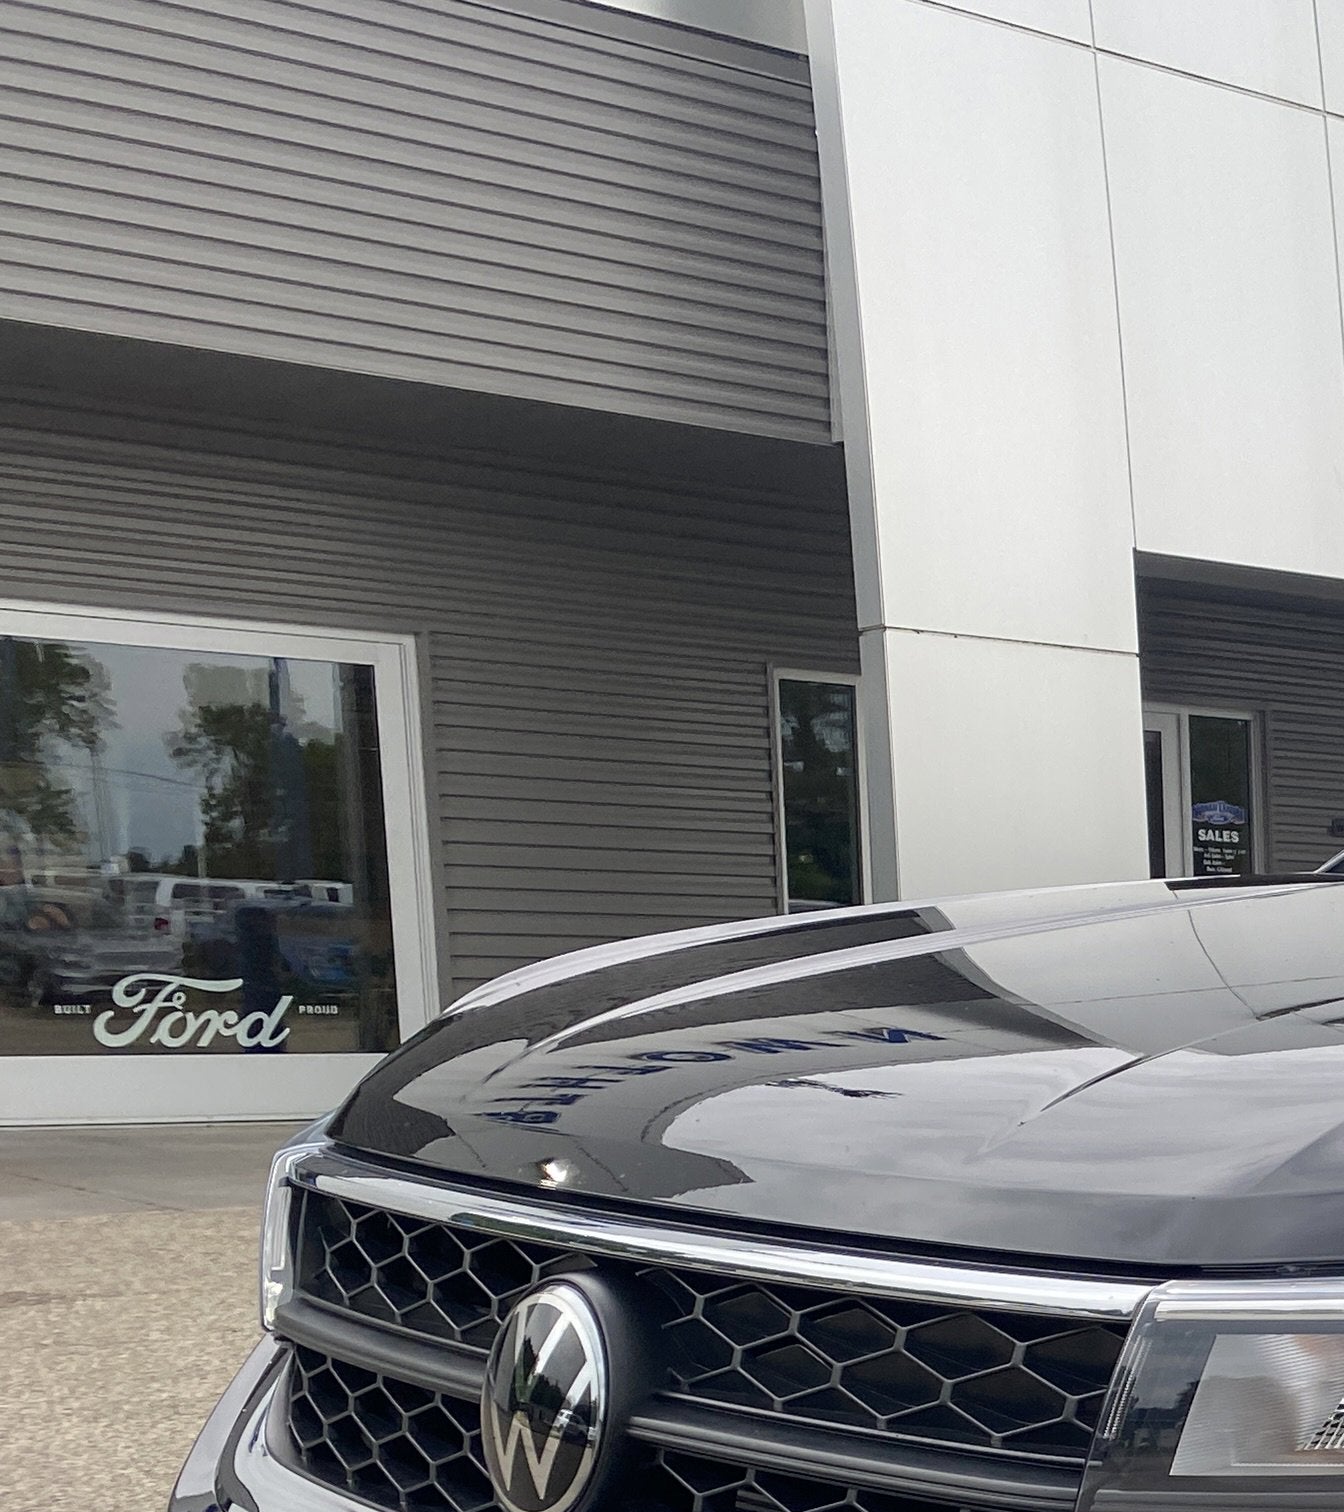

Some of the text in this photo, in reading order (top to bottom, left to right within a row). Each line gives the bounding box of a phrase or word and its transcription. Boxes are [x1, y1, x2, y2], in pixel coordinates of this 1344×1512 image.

[1198, 828, 1240, 843] SALES
[54, 973, 338, 1048] BUILT Ford PROUD
